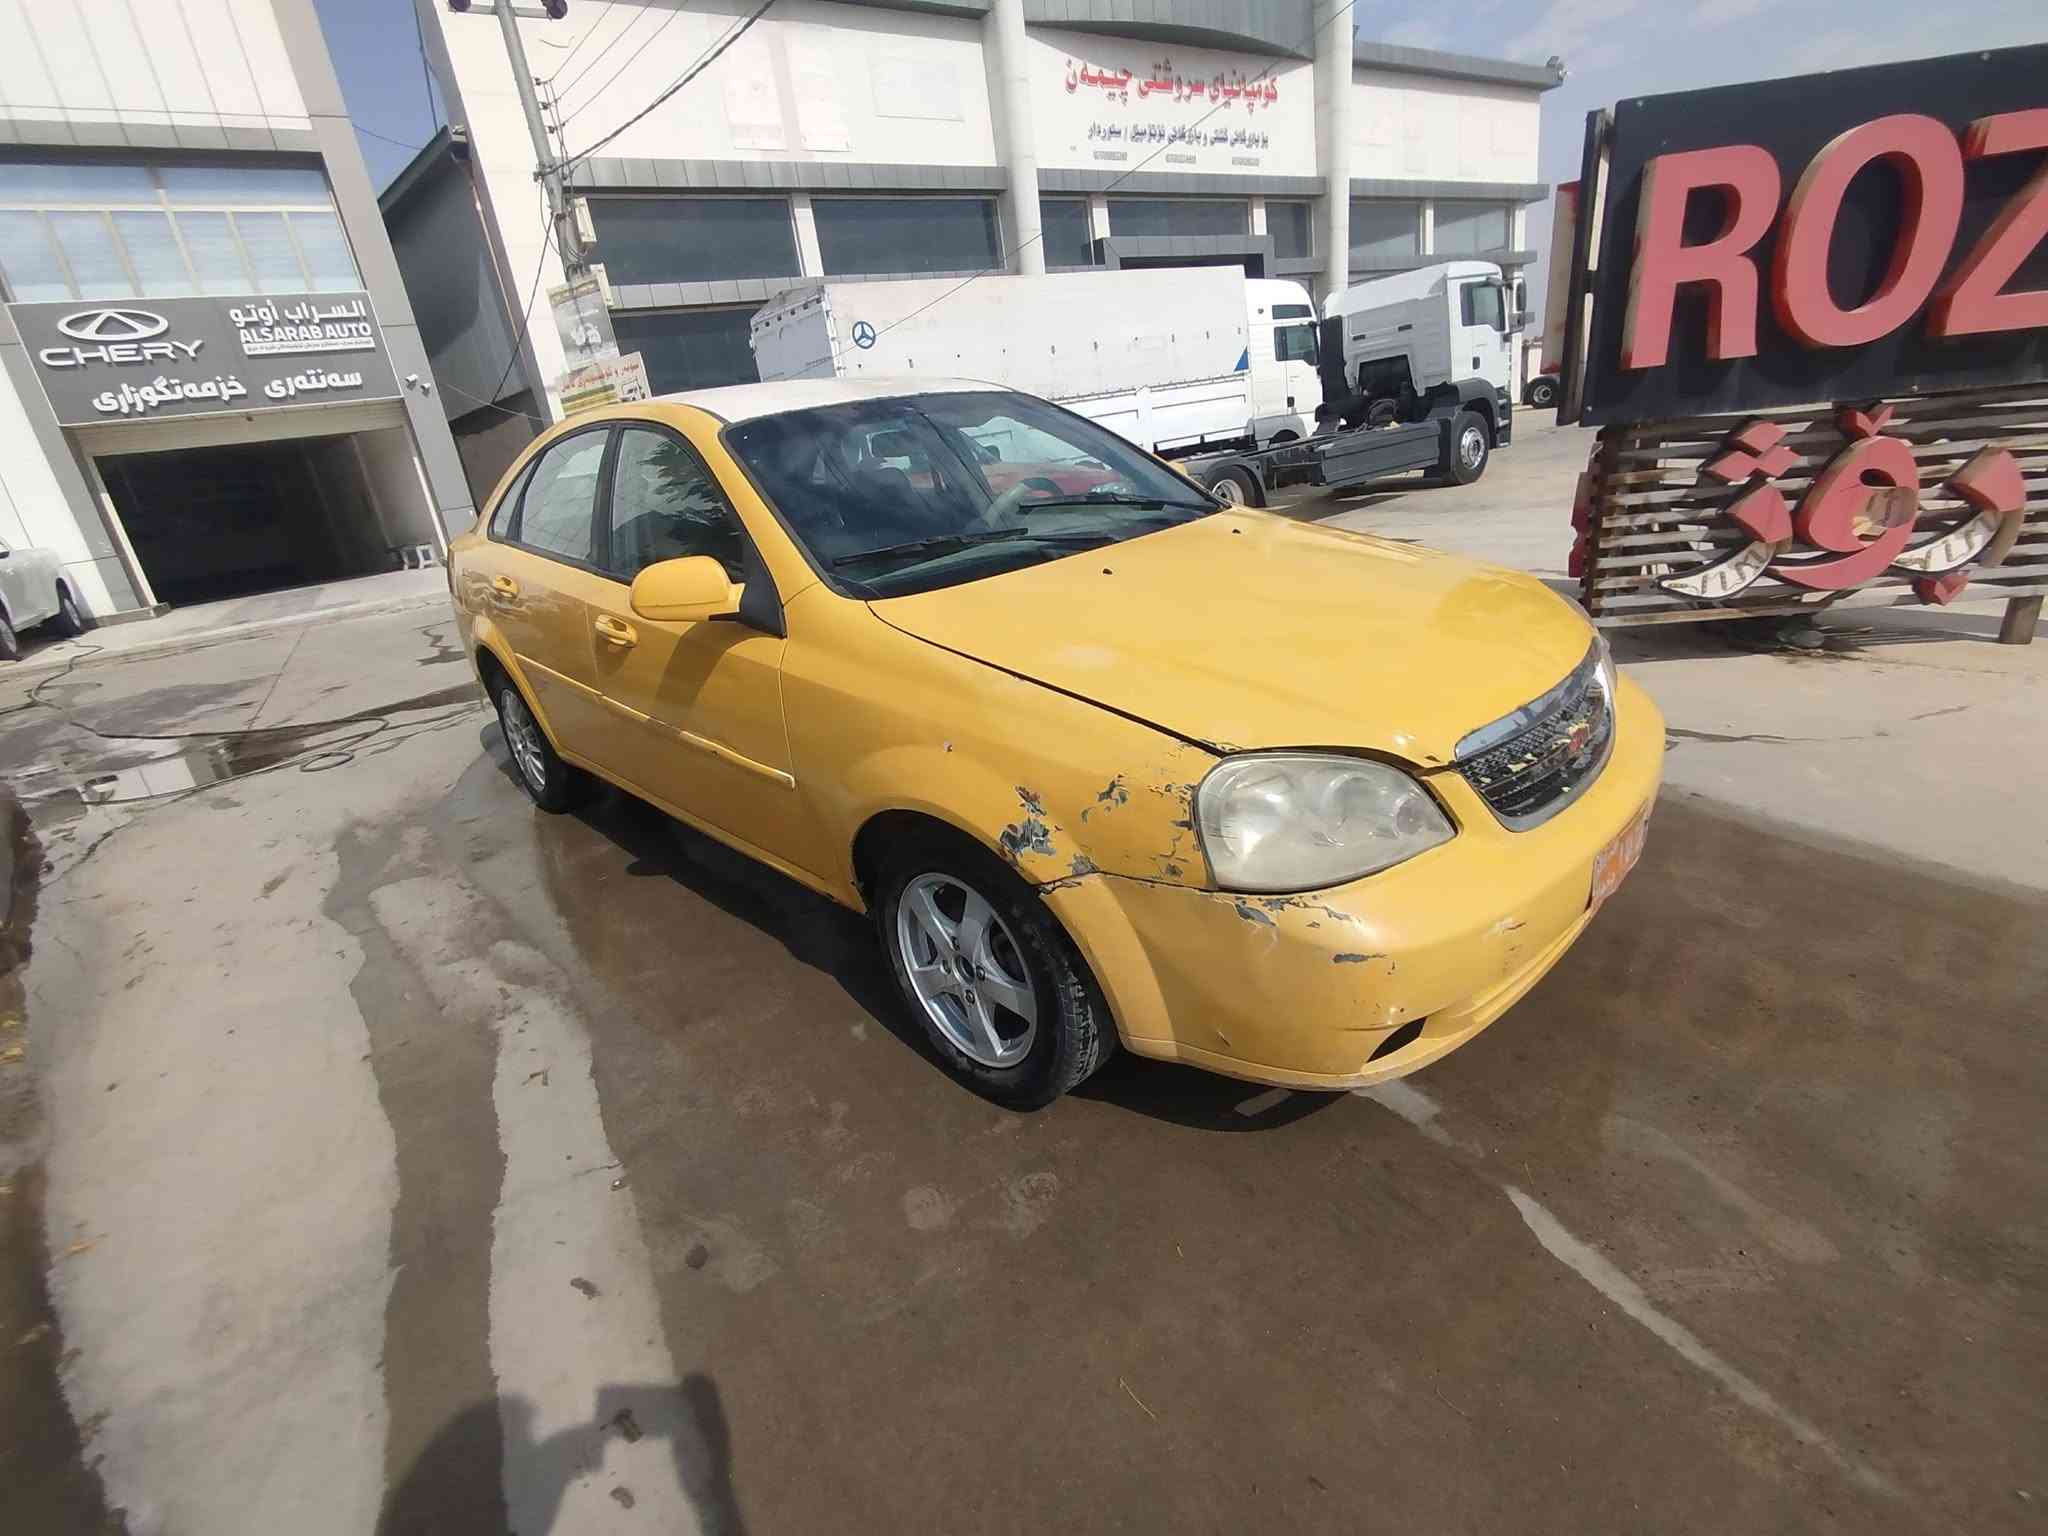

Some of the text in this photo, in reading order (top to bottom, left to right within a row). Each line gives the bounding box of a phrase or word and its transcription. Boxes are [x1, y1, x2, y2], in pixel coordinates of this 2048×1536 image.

[229, 299, 367, 328] السراب أوتو
[239, 322, 372, 344] ALSARAB AUTO
[39, 339, 203, 367] CHERY
